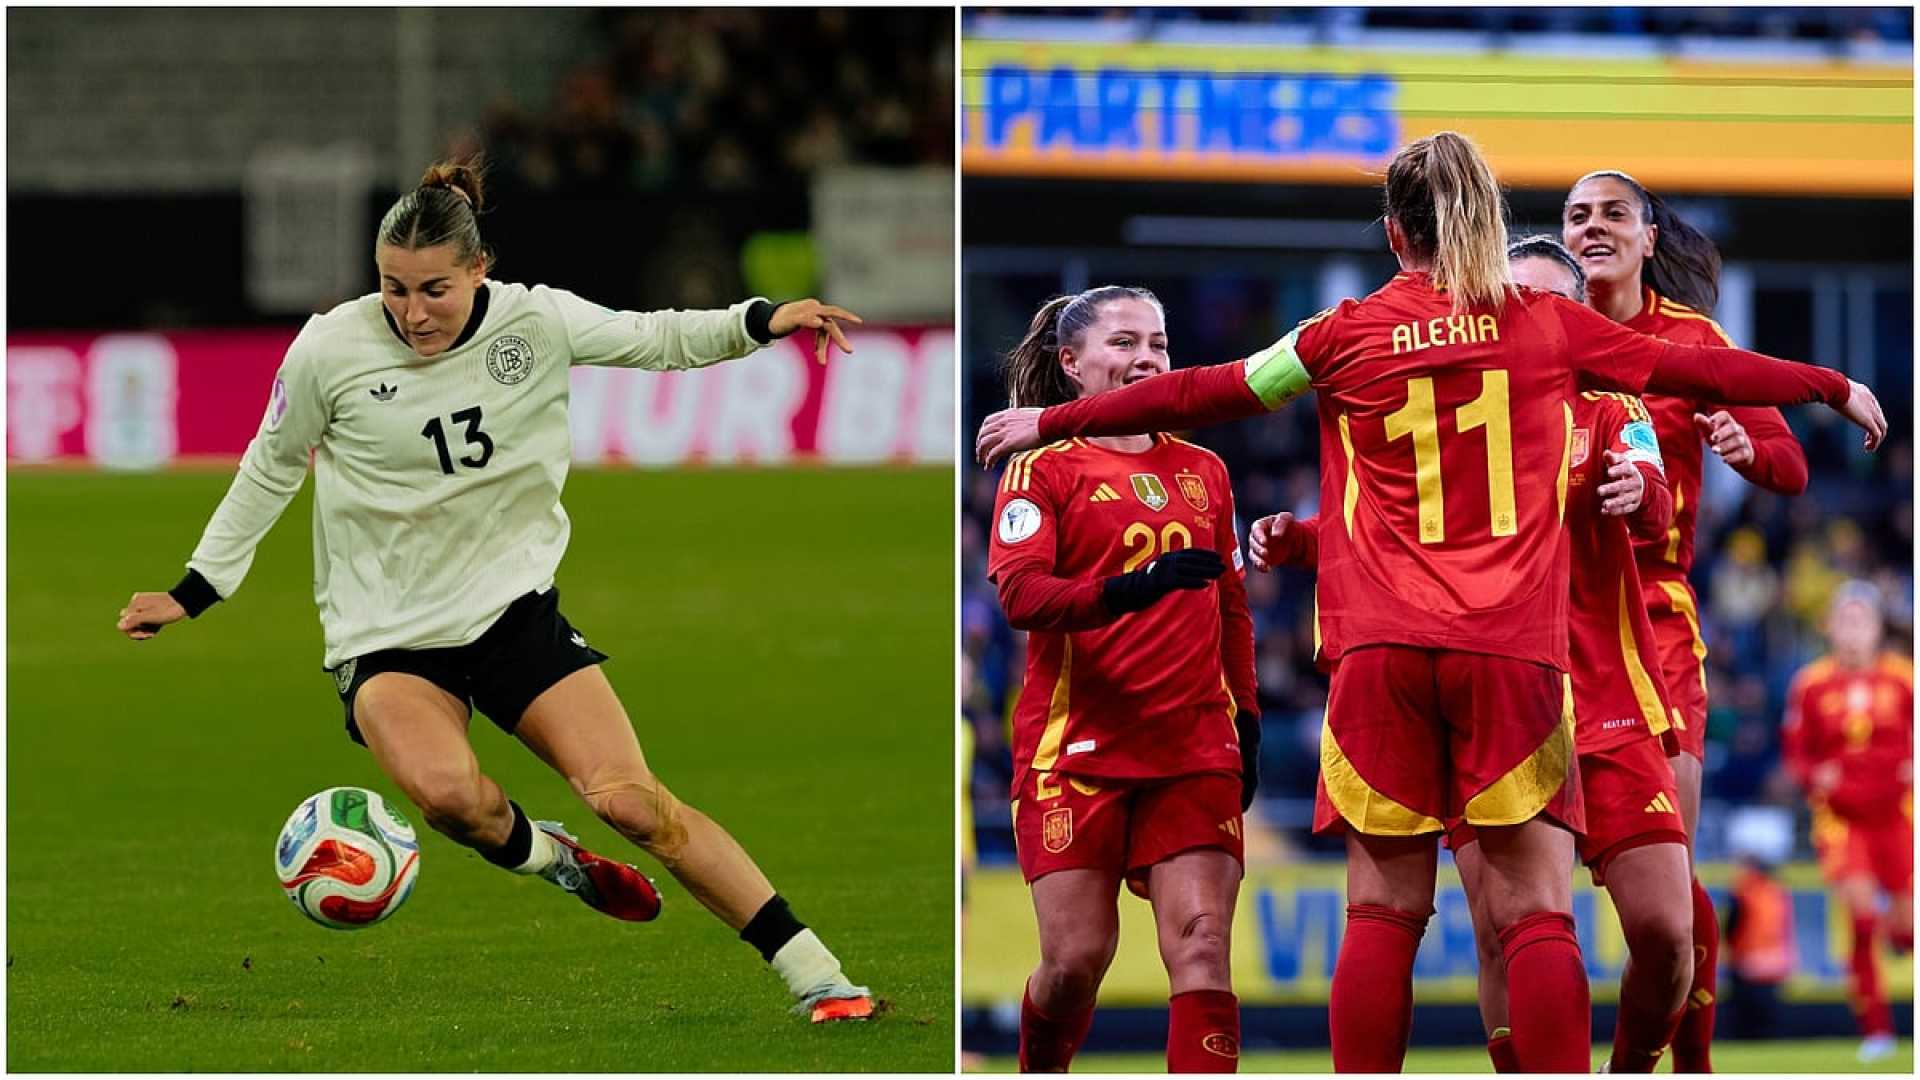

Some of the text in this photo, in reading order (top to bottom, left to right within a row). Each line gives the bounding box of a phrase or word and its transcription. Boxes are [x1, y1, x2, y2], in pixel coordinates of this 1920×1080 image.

[985, 66, 1397, 157] PARTNERS
[1392, 313, 1500, 355] ALEXIA
[421, 405, 494, 475] 13
[1383, 369, 1518, 544] 11
